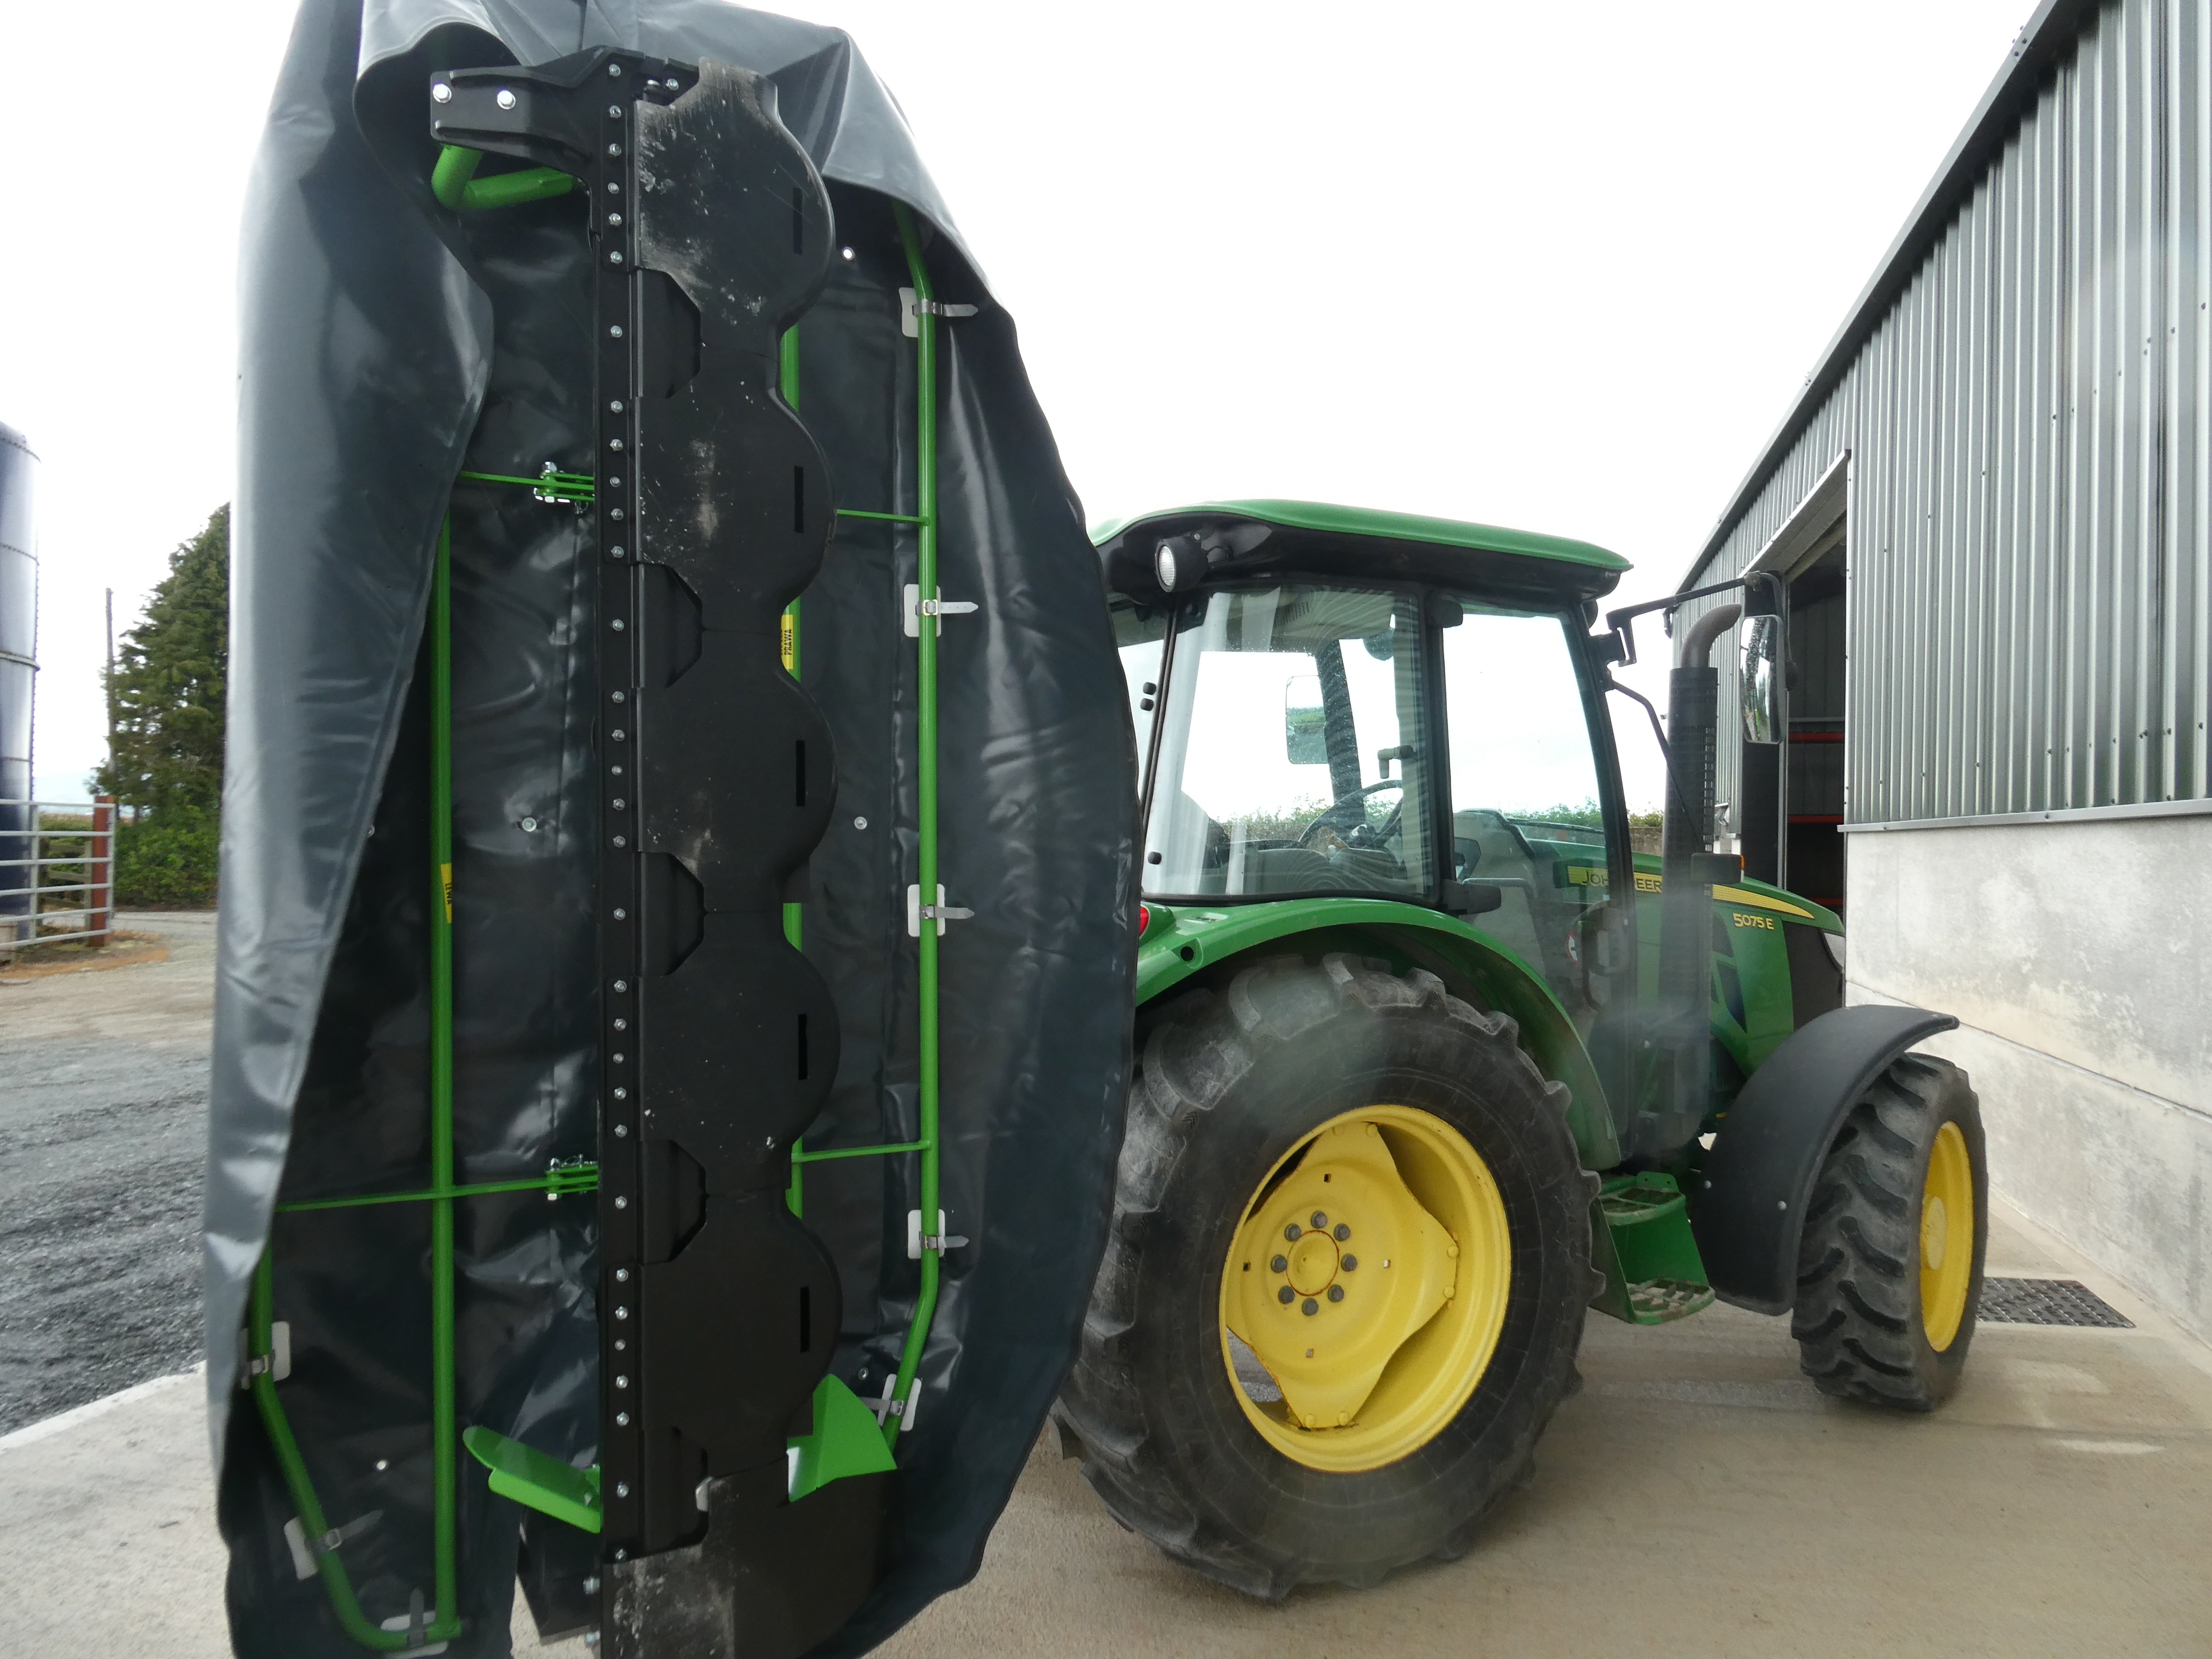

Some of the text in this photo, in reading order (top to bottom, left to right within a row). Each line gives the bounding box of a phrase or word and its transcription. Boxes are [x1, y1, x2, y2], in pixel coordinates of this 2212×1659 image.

[784, 629, 792, 655] PRAWA
[1582, 870, 1662, 892] JOH EER
